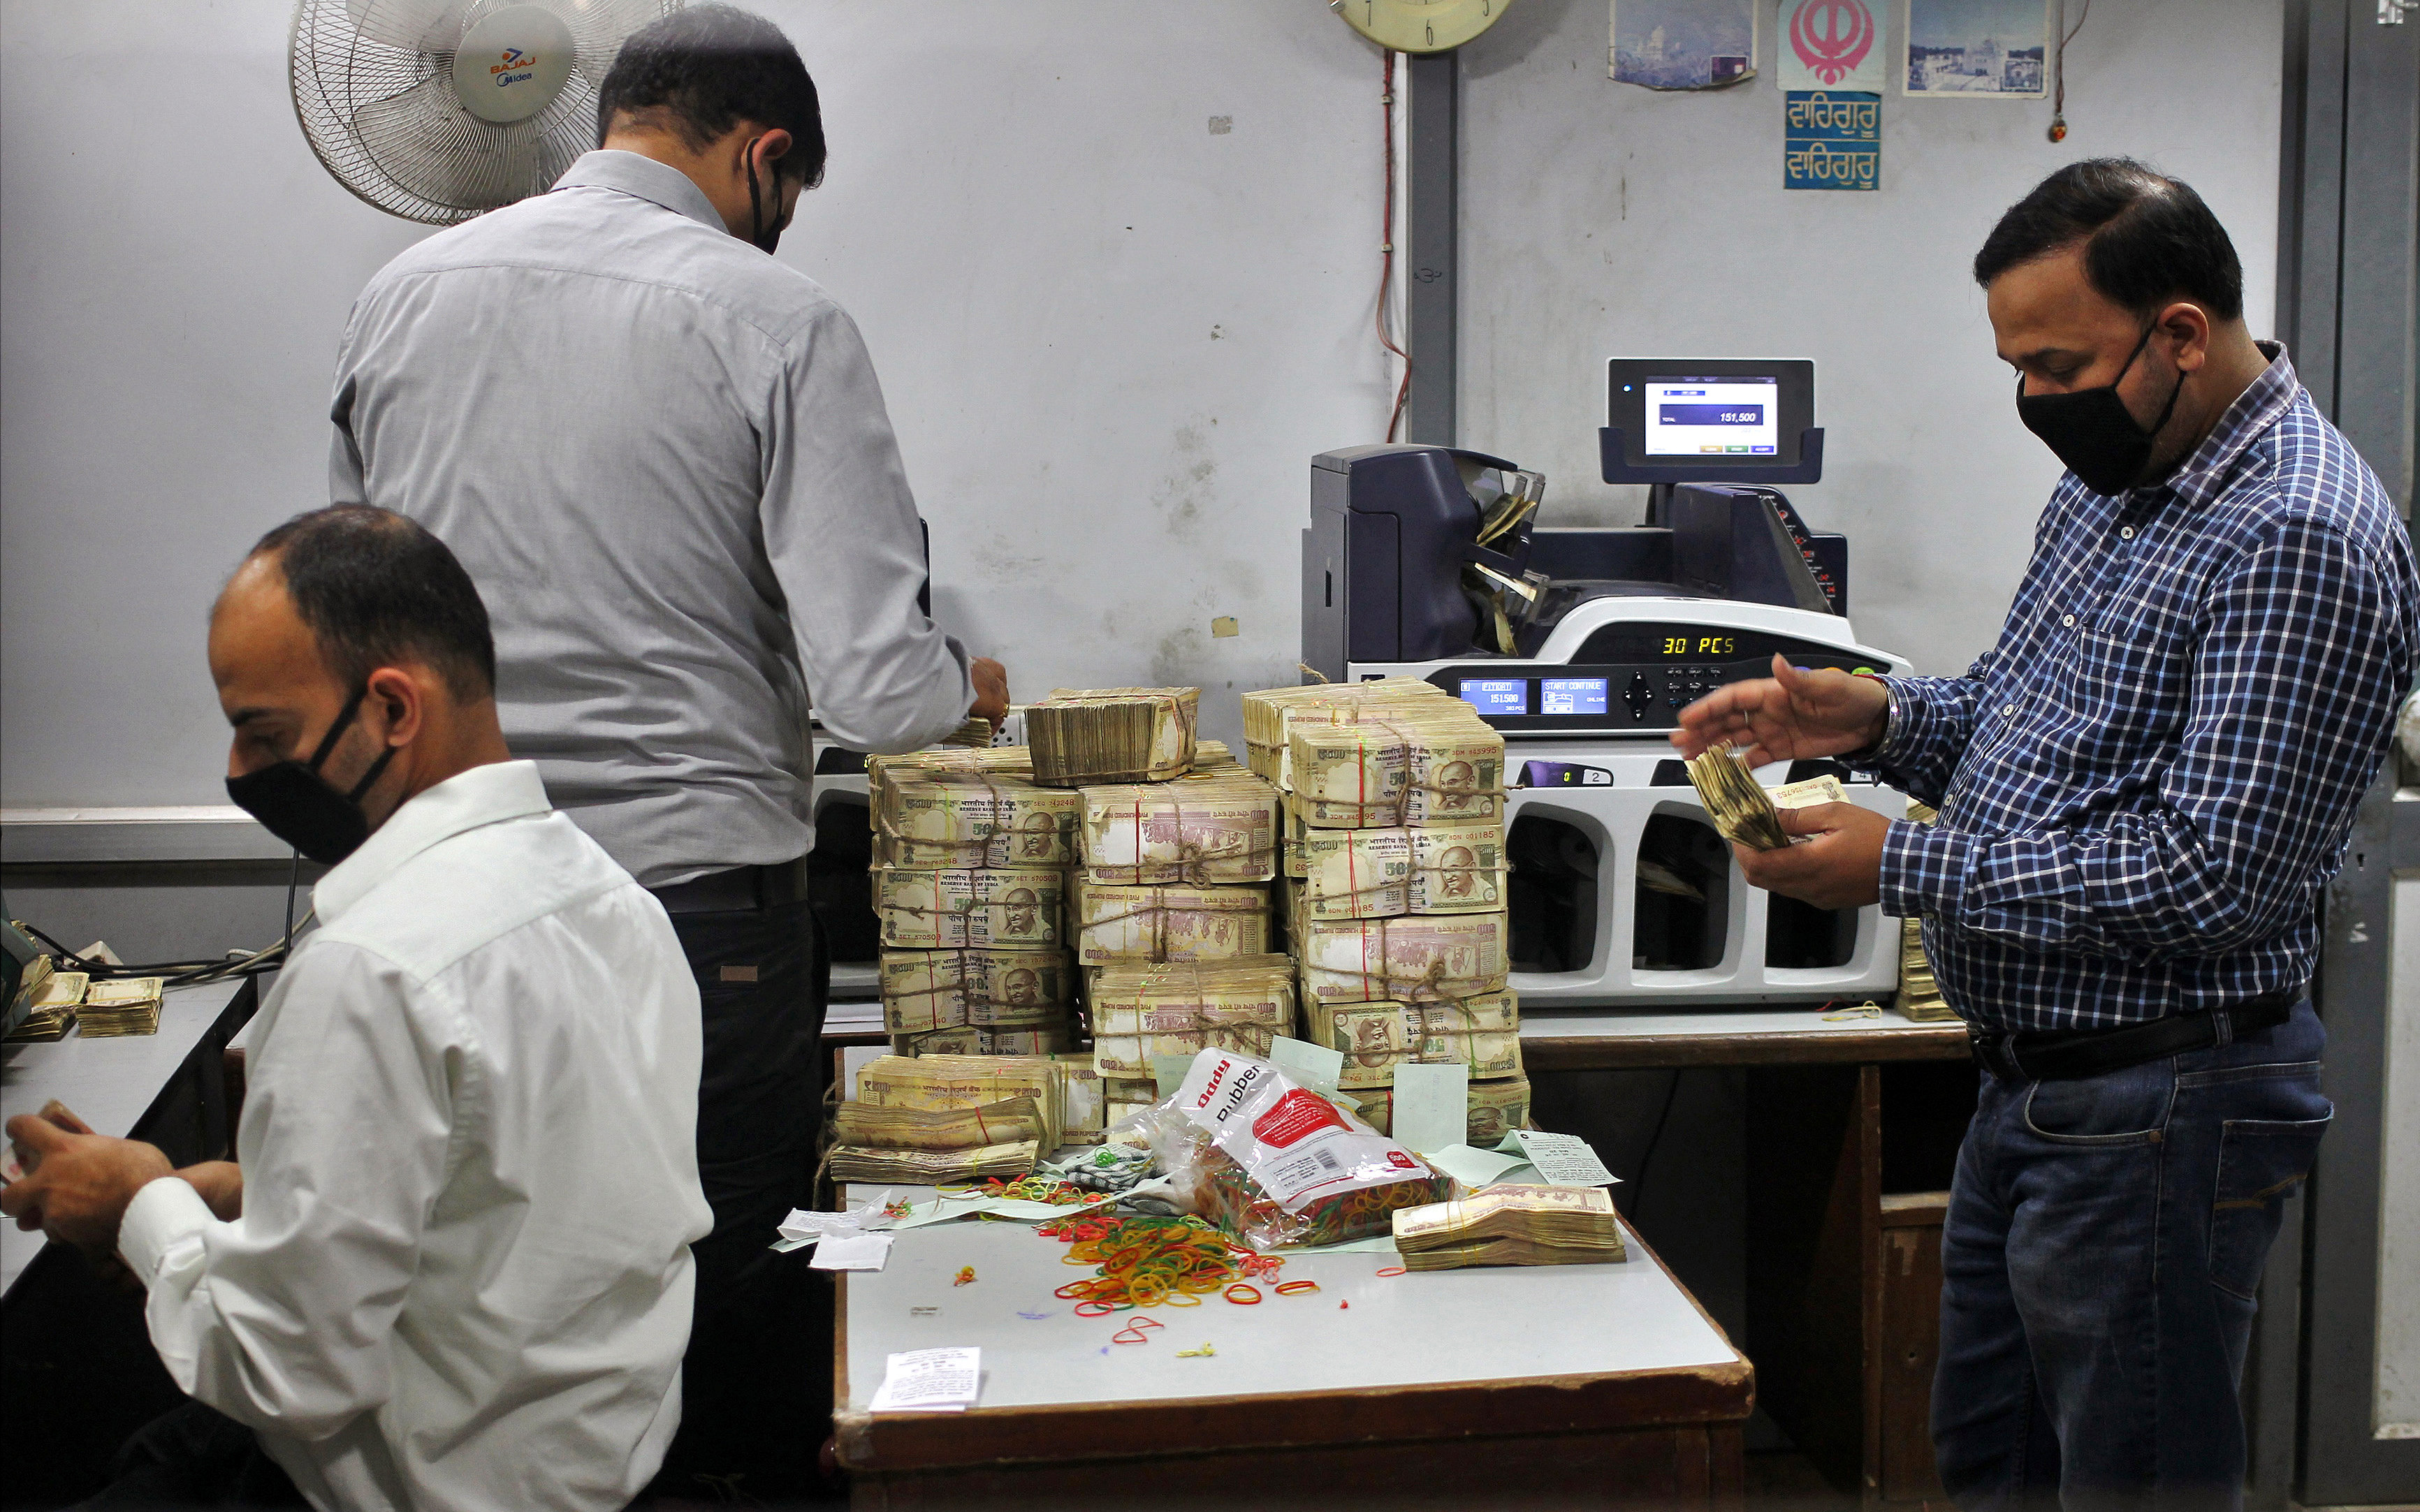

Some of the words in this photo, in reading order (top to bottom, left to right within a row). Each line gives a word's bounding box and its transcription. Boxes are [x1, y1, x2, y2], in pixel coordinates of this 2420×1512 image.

[1425, 19, 1434, 46] 6
[490, 57, 536, 74] BAJAJ
[497, 72, 532, 87] Midea
[1788, 91, 1879, 138] ਵਾਹਿਗੁਰੂ
[1787, 142, 1878, 189] ਵਾਹਿਗੁਰੂ
[1720, 413, 1756, 423] 151,500
[1663, 638, 1686, 654] 30
[1698, 638, 1734, 654] PCS
[1545, 682, 1566, 690] START
[1568, 682, 1601, 690] CONTINUE
[1563, 772, 1570, 781] 0
[1592, 772, 1599, 781] 2
[1347, 812, 1376, 821] 84595
[1197, 1059, 1230, 1108] Oddy
